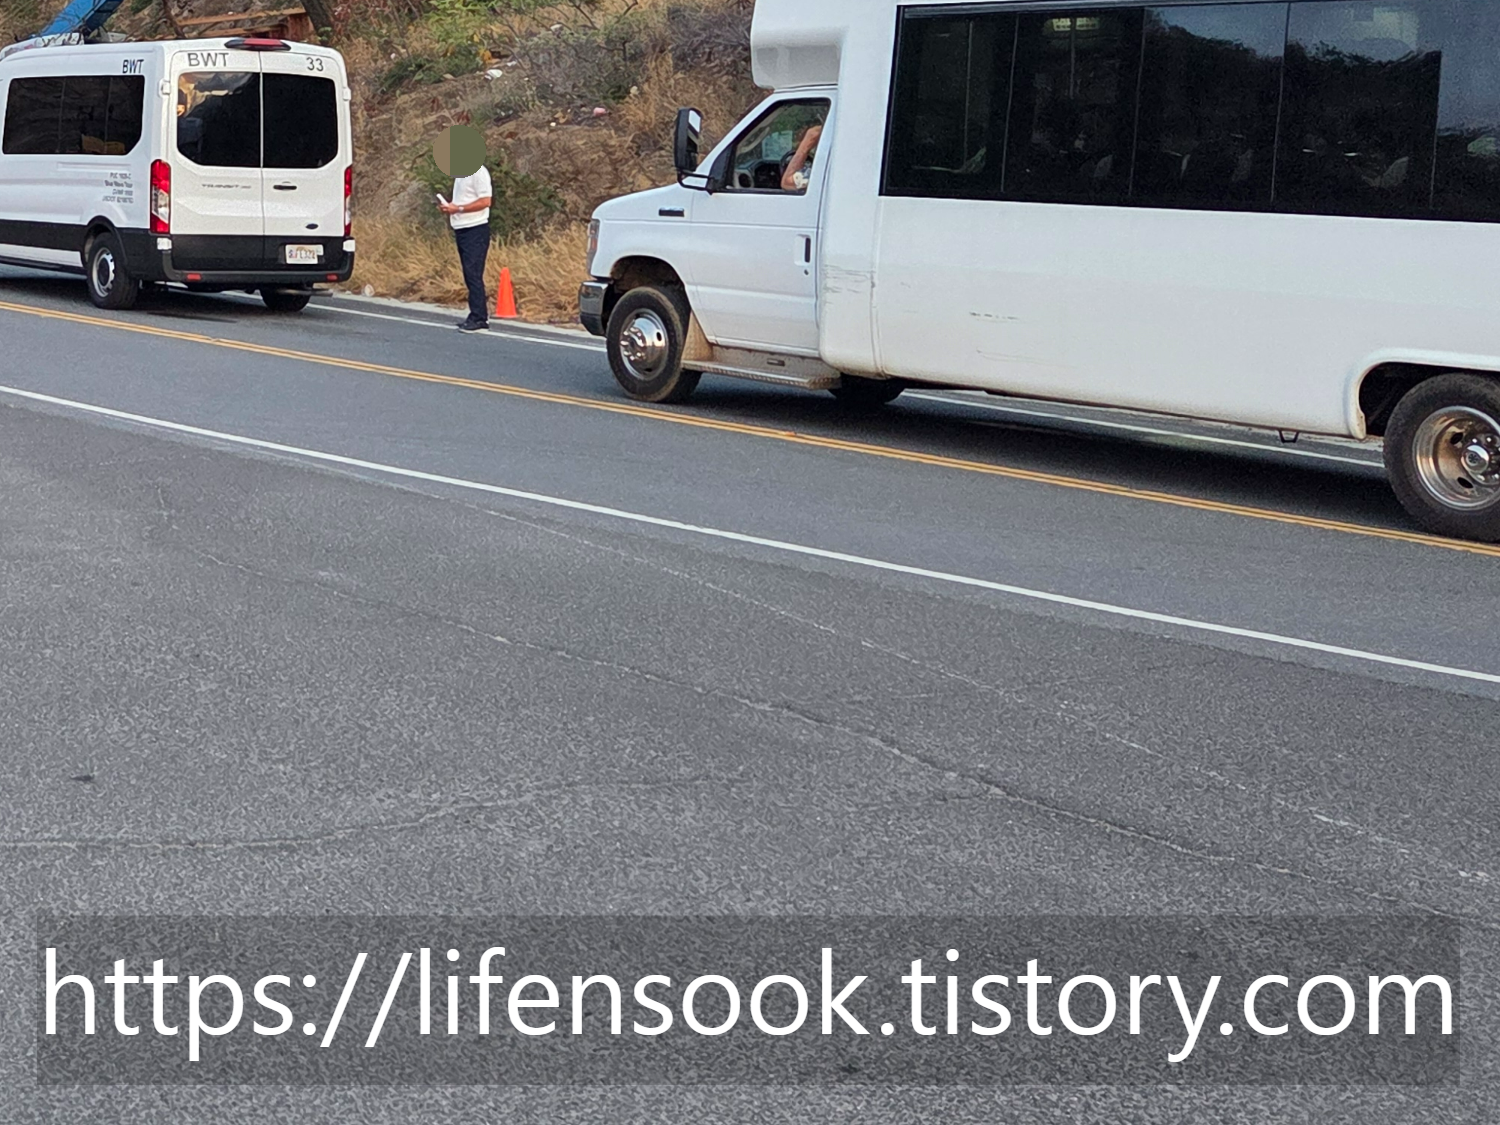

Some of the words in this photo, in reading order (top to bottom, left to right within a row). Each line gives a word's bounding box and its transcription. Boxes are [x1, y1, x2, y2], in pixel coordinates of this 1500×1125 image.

[122, 59, 145, 74] BWT
[187, 52, 229, 67] BWT
[306, 56, 324, 72] 33
